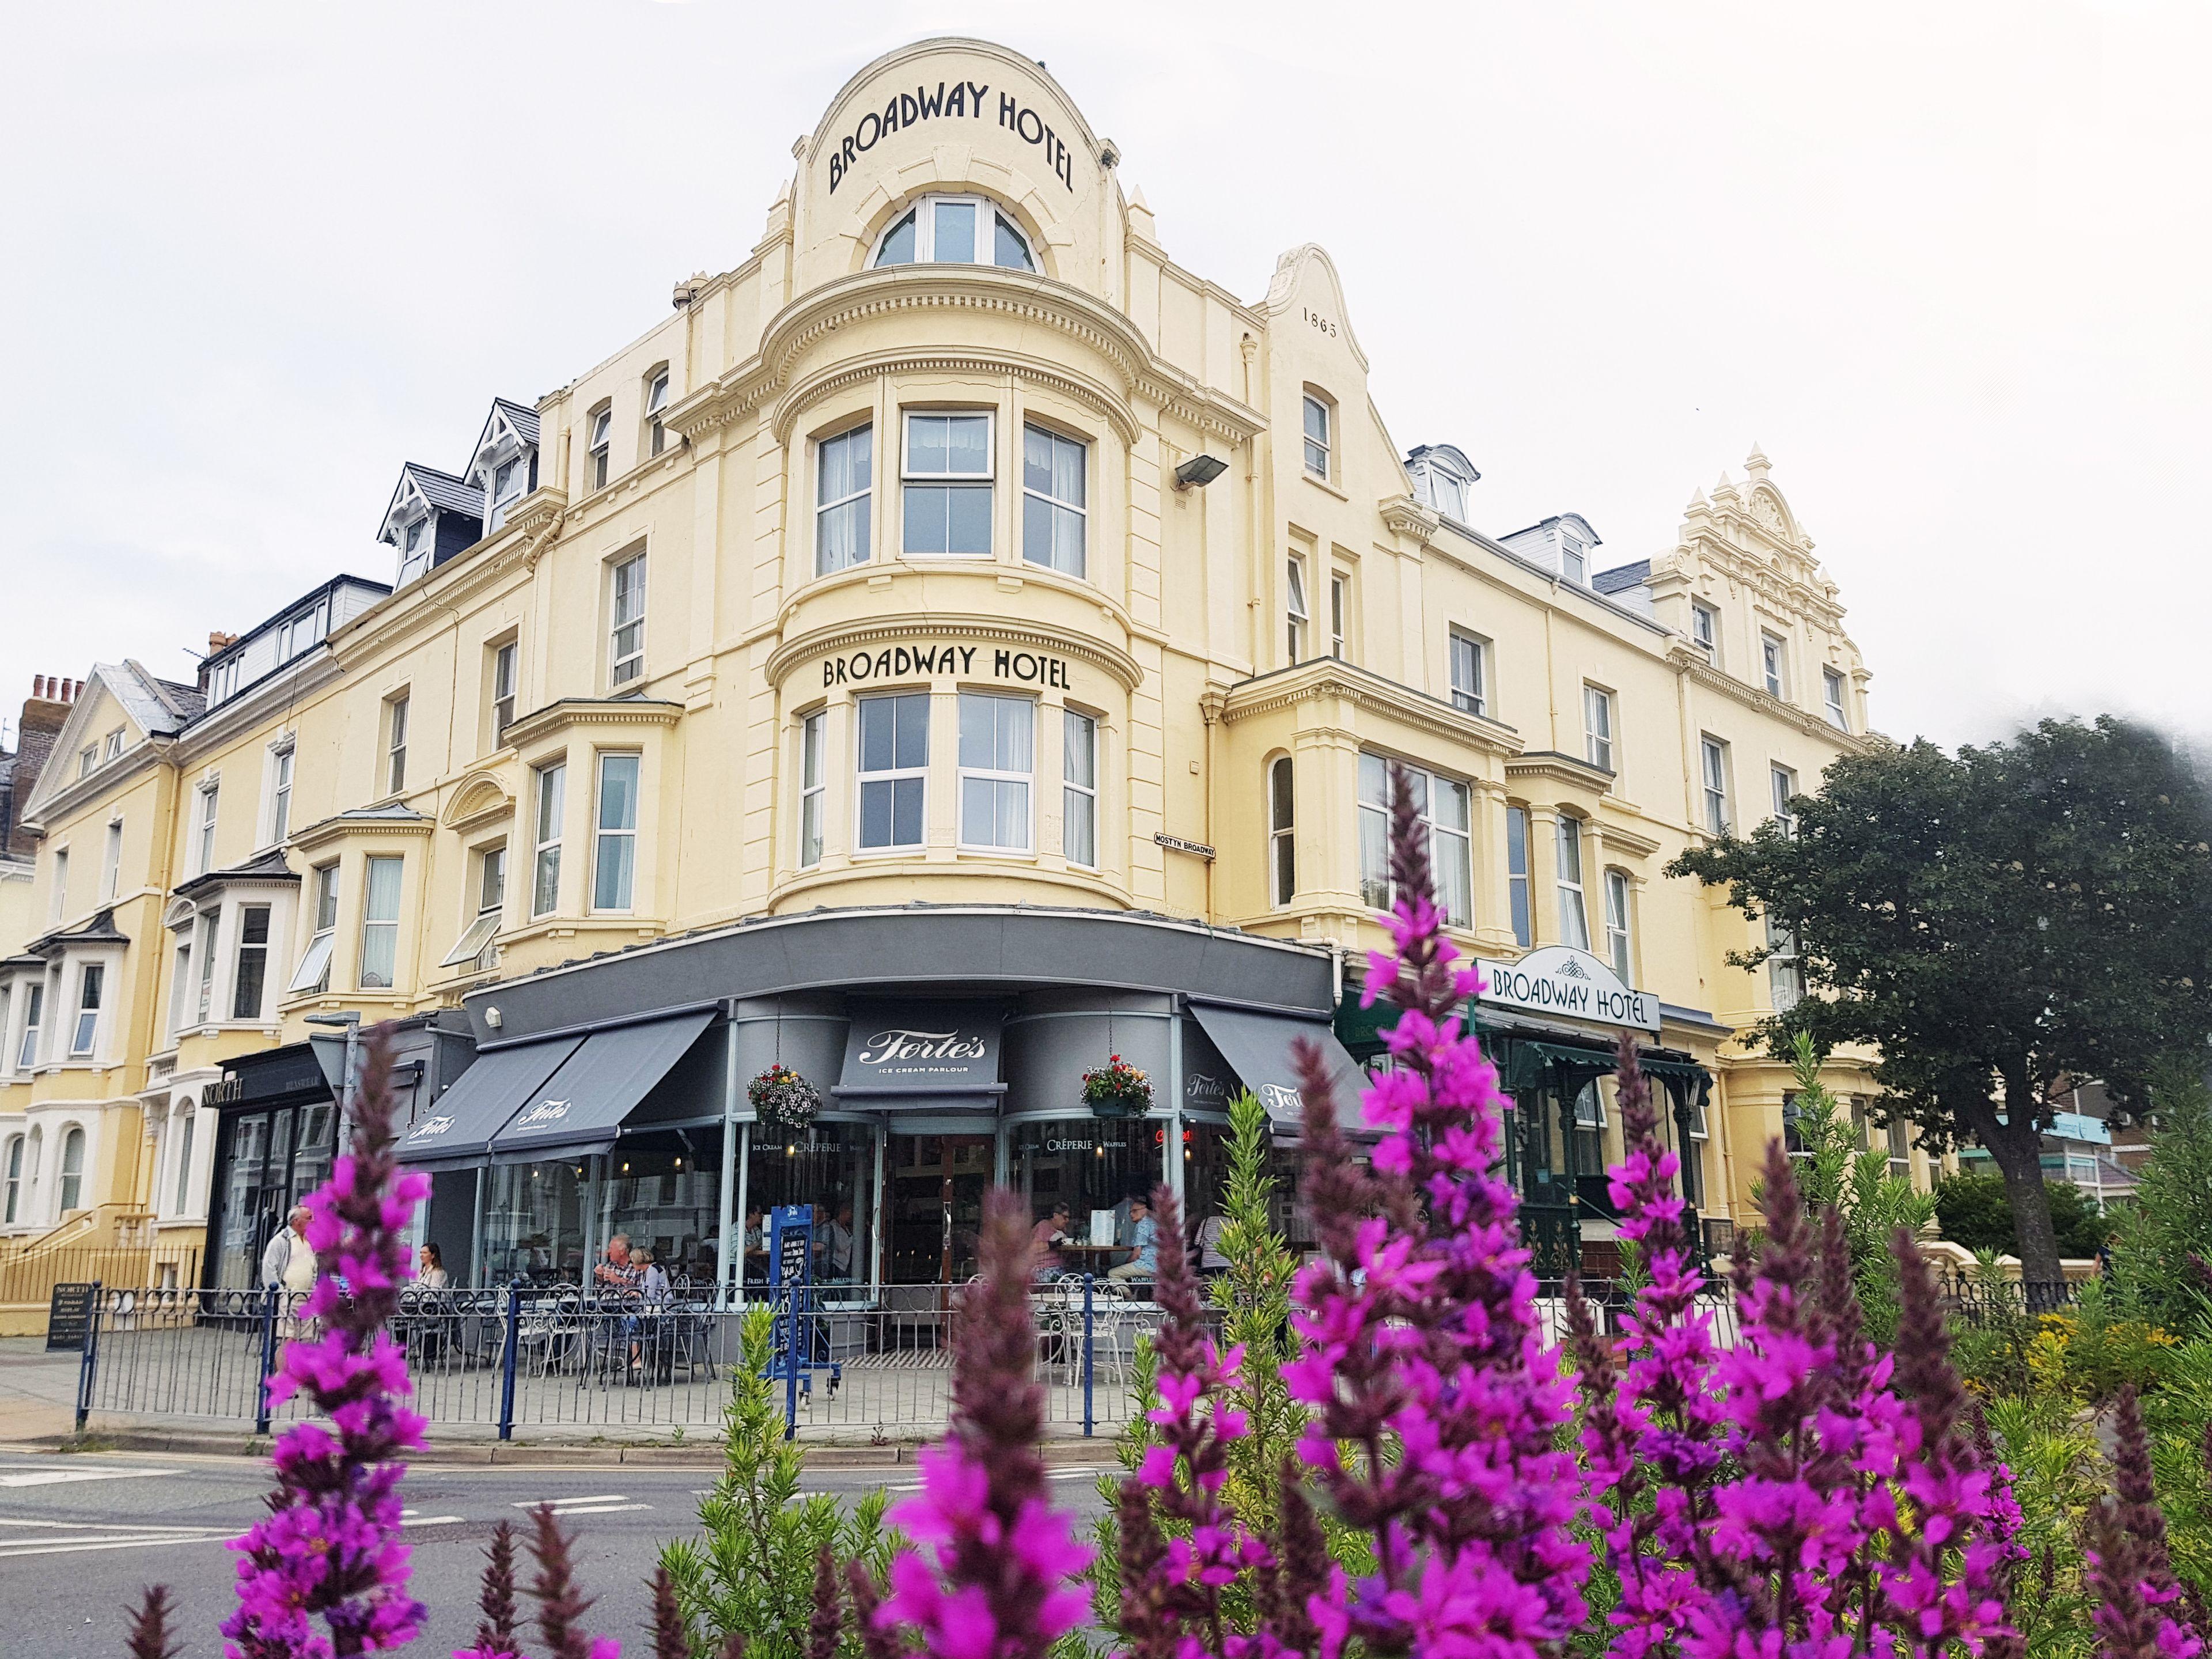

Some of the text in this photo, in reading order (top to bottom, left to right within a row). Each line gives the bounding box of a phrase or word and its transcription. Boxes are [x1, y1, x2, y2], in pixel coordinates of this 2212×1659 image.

[830, 81, 1074, 195] BROADWAY HOTEL
[1304, 307, 1336, 338] 1865
[823, 645, 1071, 691] BROADWAY HOTEL
[1156, 834, 1215, 856] MOSTYN BROADWAY
[1493, 969, 1648, 1024] BROADWAY HOTEL
[859, 1028, 986, 1065] Forte's
[202, 1077, 244, 1107] NORTH
[1187, 1073, 1225, 1096] Forte's
[1047, 1138, 1093, 1152] CRÉPERIE
